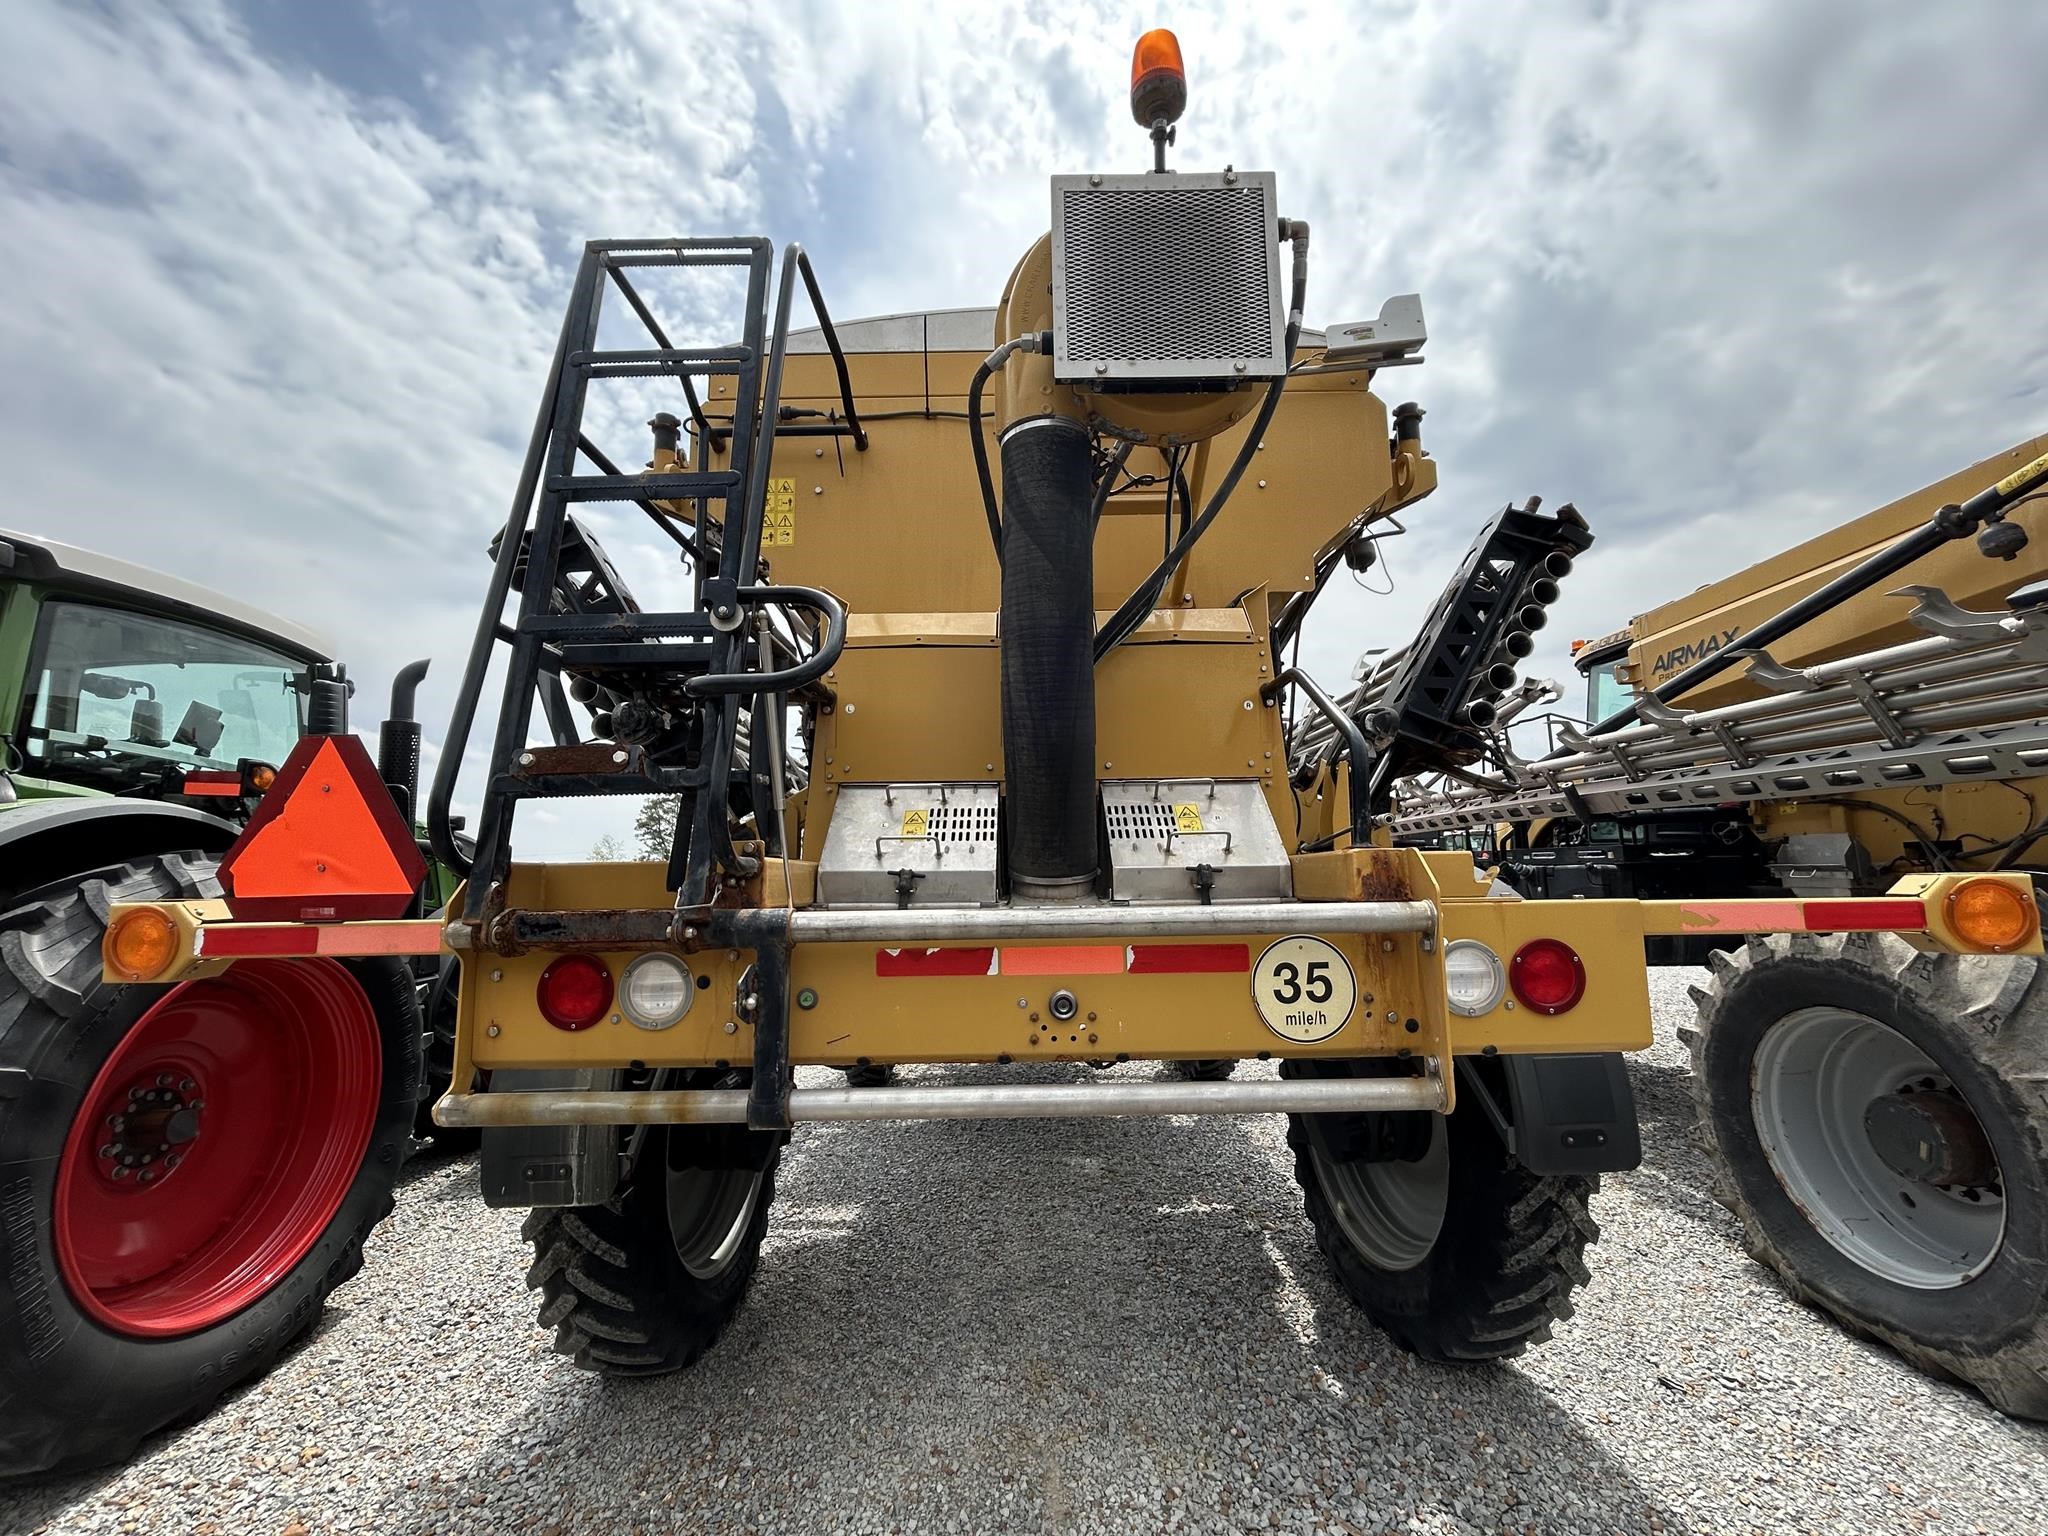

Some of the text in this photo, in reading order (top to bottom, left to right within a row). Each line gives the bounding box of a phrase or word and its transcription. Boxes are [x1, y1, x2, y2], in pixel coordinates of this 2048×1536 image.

[1652, 626, 1740, 675] AIRMAX
[1273, 961, 1333, 1005] 35
[1285, 1010, 1327, 1026] mile/h
